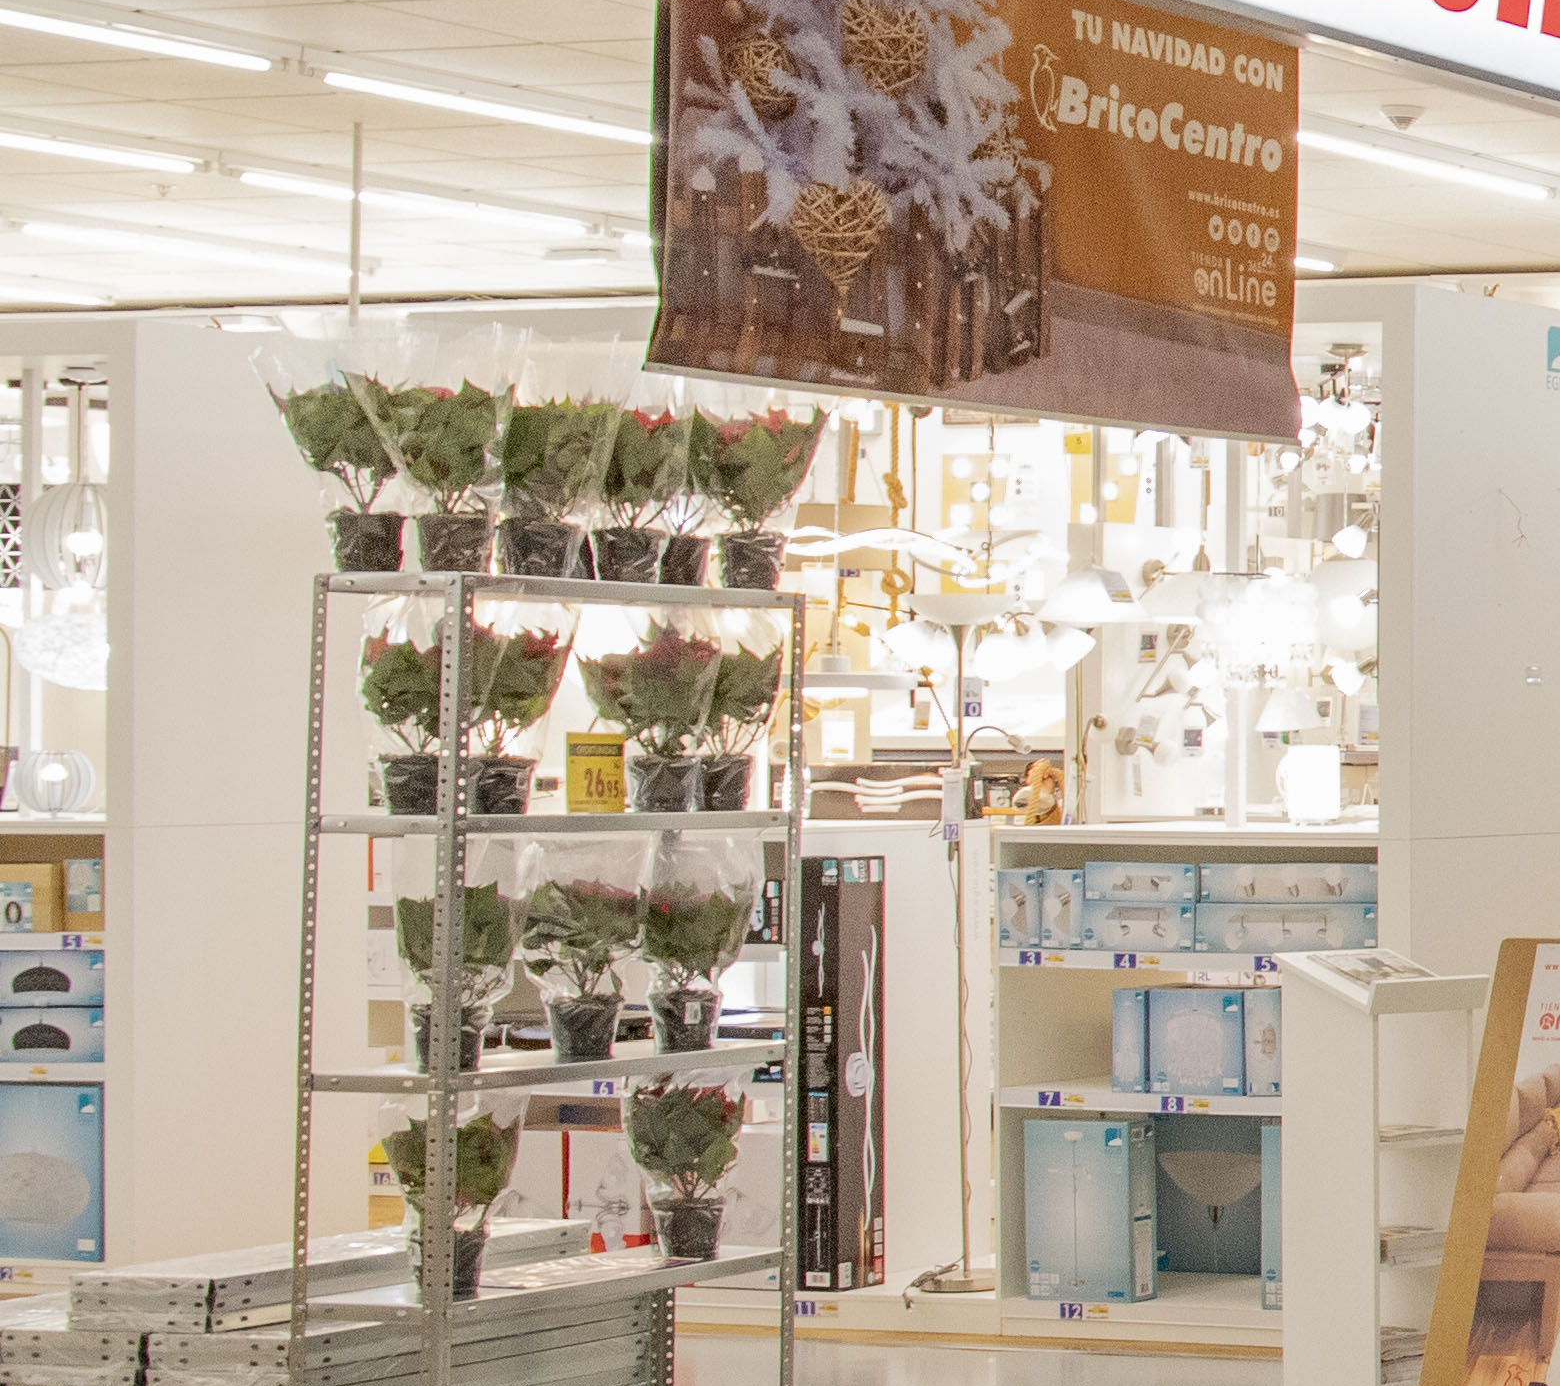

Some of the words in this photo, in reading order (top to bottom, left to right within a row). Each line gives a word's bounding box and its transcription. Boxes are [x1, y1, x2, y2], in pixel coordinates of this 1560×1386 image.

[1071, 8, 1102, 44] TU
[1111, 20, 1226, 76] NAVIDAD
[1233, 53, 1284, 93] CON
[1056, 74, 1283, 173] BricoCentro
[1024, 951, 1036, 965] 3
[1120, 955, 1130, 969] 4
[599, 1082, 609, 1095] 6
[1167, 1097, 1177, 1112] 8
[1062, 1304, 1082, 1319] 12
